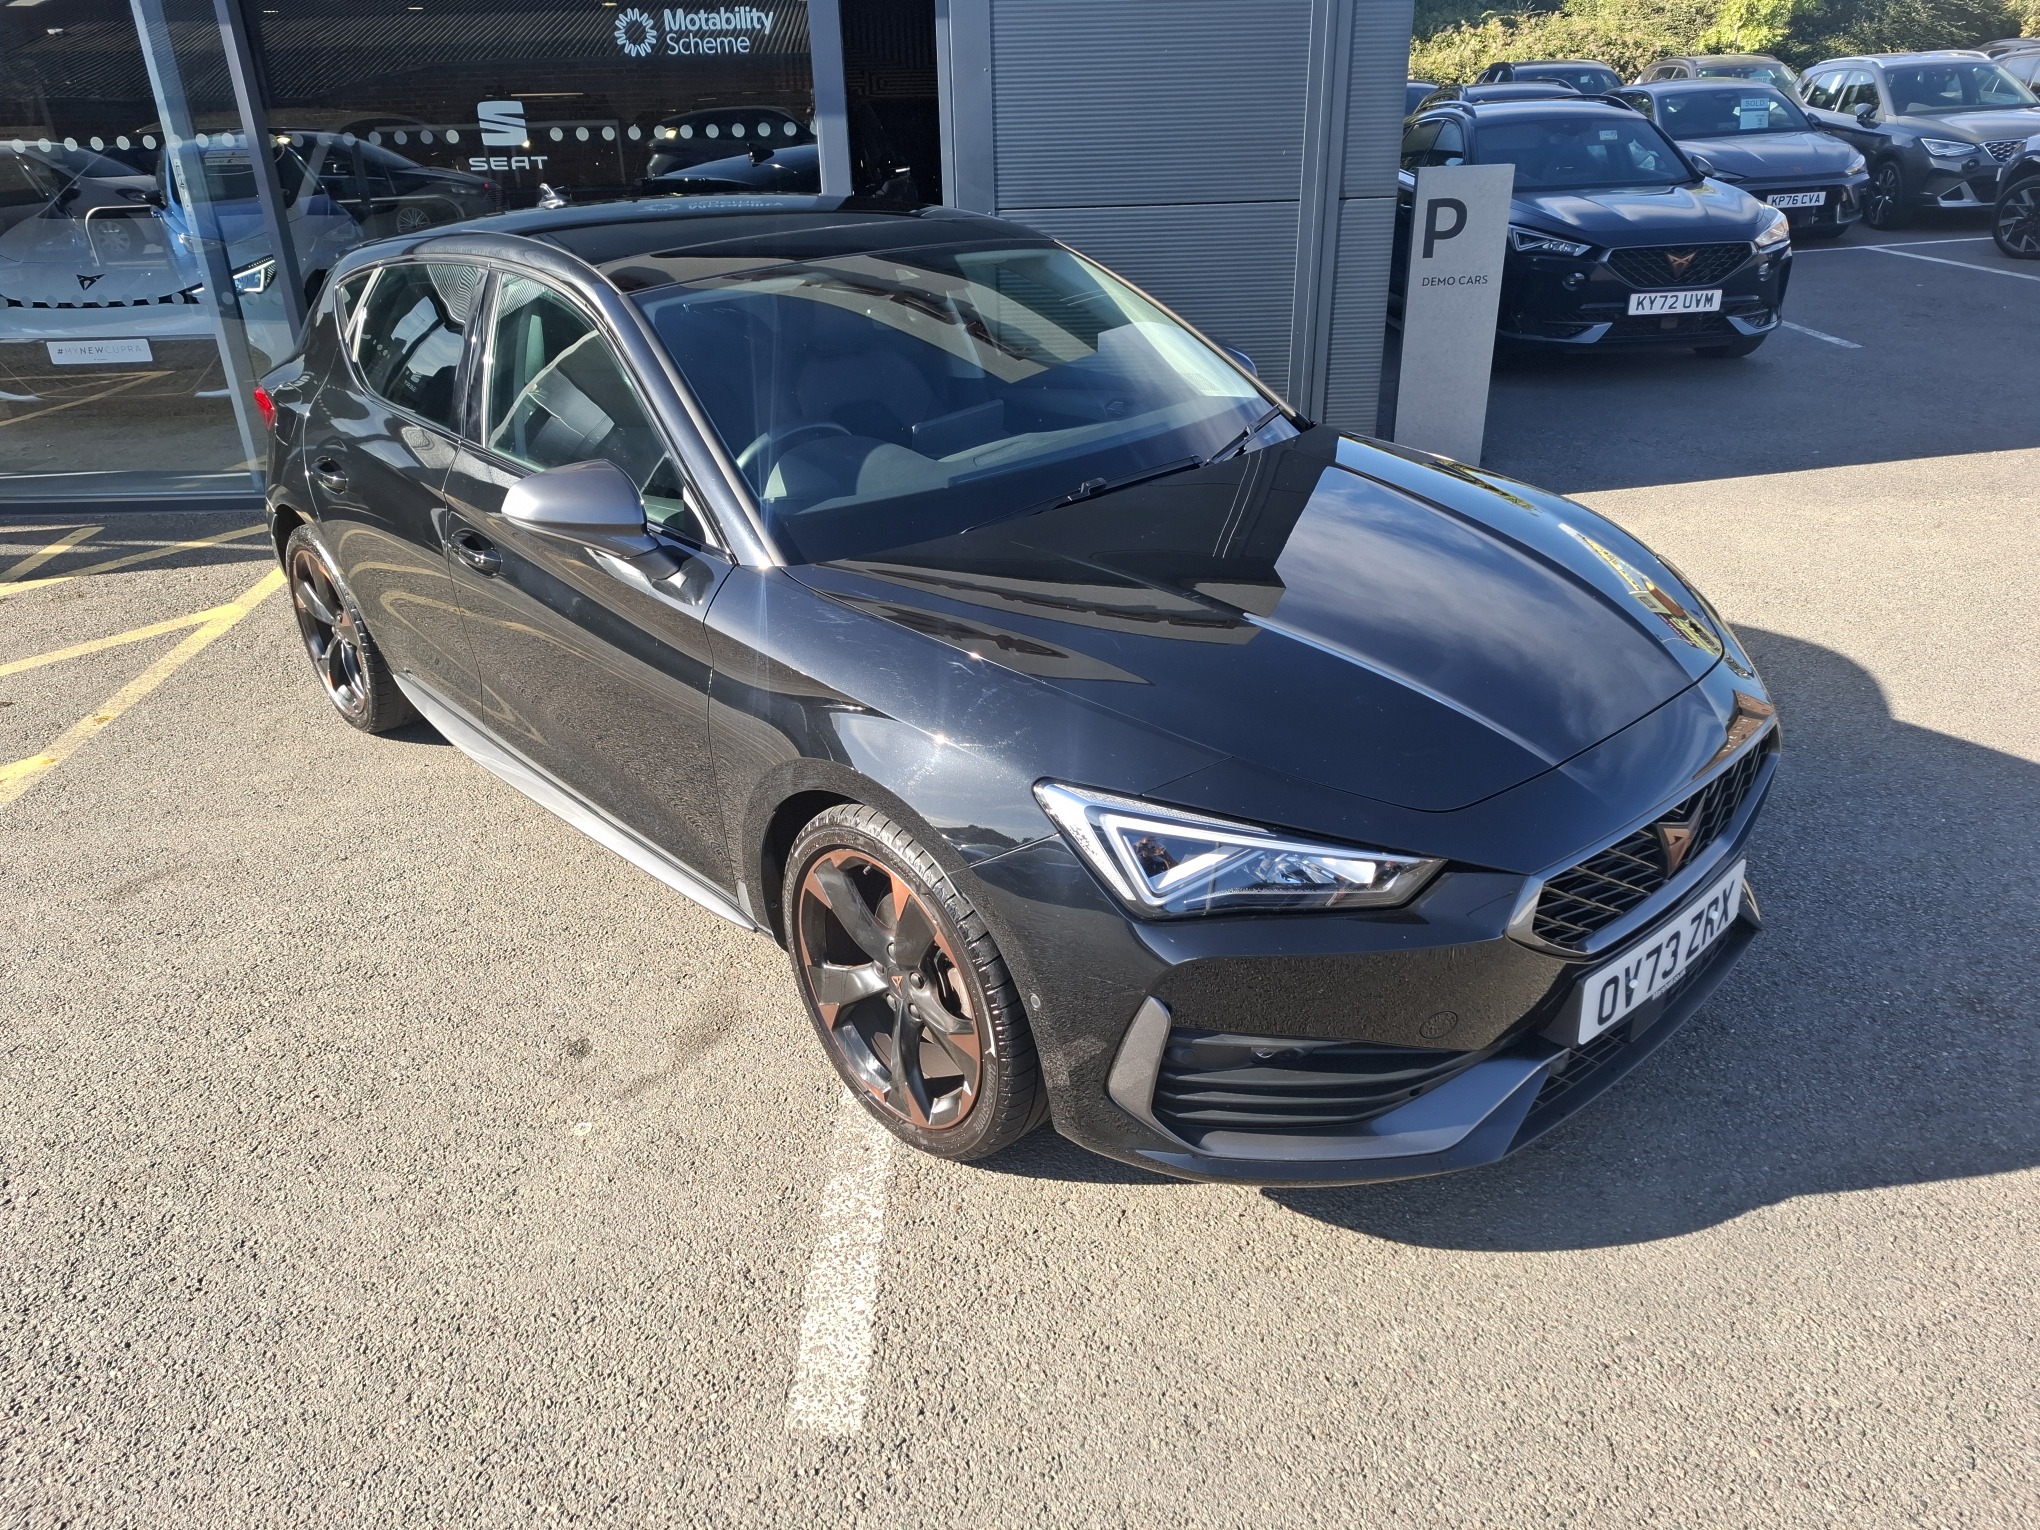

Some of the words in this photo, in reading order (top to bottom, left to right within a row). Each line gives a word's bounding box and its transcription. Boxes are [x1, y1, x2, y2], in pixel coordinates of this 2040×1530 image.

[663, 6, 774, 35] Motability
[666, 32, 750, 55] Scheme
[468, 155, 548, 171] SEAT
[1771, 195, 1799, 206] KP76
[1801, 193, 1820, 205] CVA
[1422, 197, 1468, 259] P
[1422, 276, 1456, 287] DEMO
[1458, 275, 1488, 286] CARS
[1636, 295, 1679, 311] KY72
[1682, 292, 1715, 309] UVM
[57, 344, 142, 356] #MYNEWCUPRA
[1597, 930, 1681, 1026] OV73
[1685, 879, 1735, 962] ZRX
